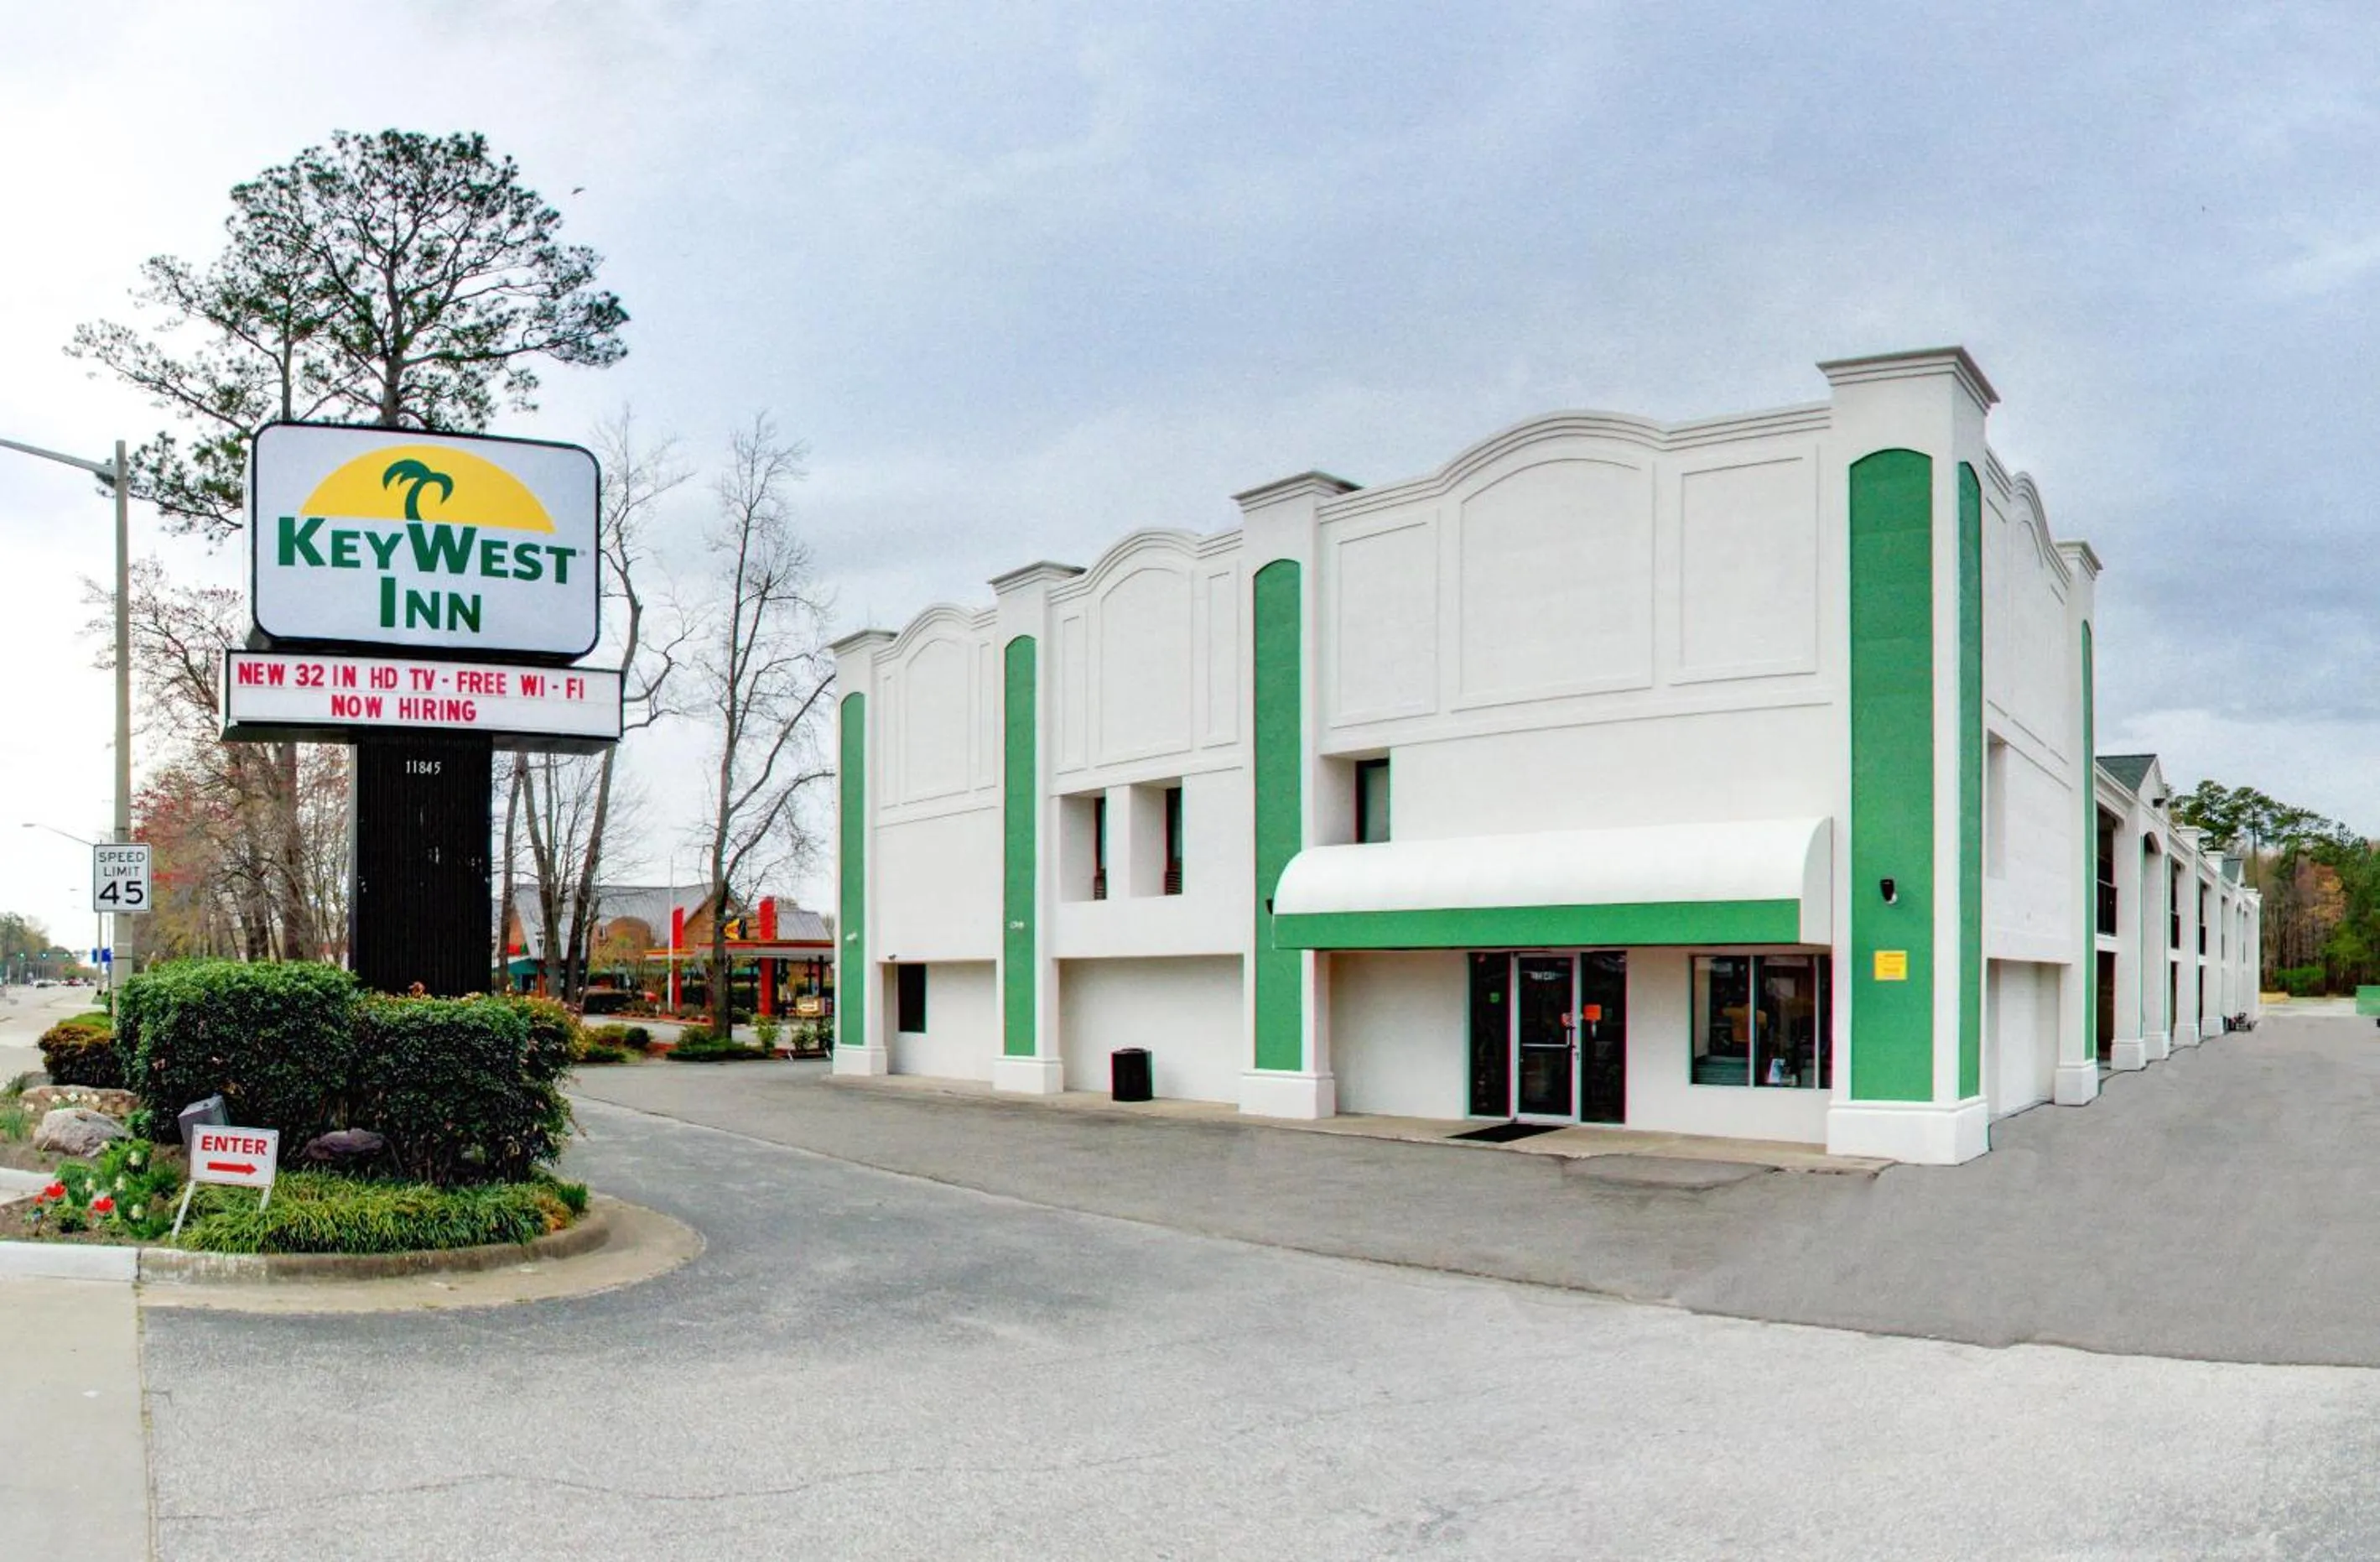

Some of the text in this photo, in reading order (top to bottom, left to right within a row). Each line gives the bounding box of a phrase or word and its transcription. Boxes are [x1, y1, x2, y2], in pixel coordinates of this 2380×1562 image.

[380, 576, 481, 634] INN
[237, 661, 286, 686] NEW
[295, 663, 325, 687] 32
[333, 664, 356, 688] IN
[371, 666, 398, 690] HD
[409, 668, 436, 691] TV
[456, 670, 507, 695] FREE
[331, 695, 477, 722] NOW HIRING
[406, 759, 442, 776] 11845
[98, 851, 146, 863] SPEED
[103, 866, 141, 877] LIMIT
[98, 880, 144, 905] 45
[200, 1134, 268, 1156] ENTER
